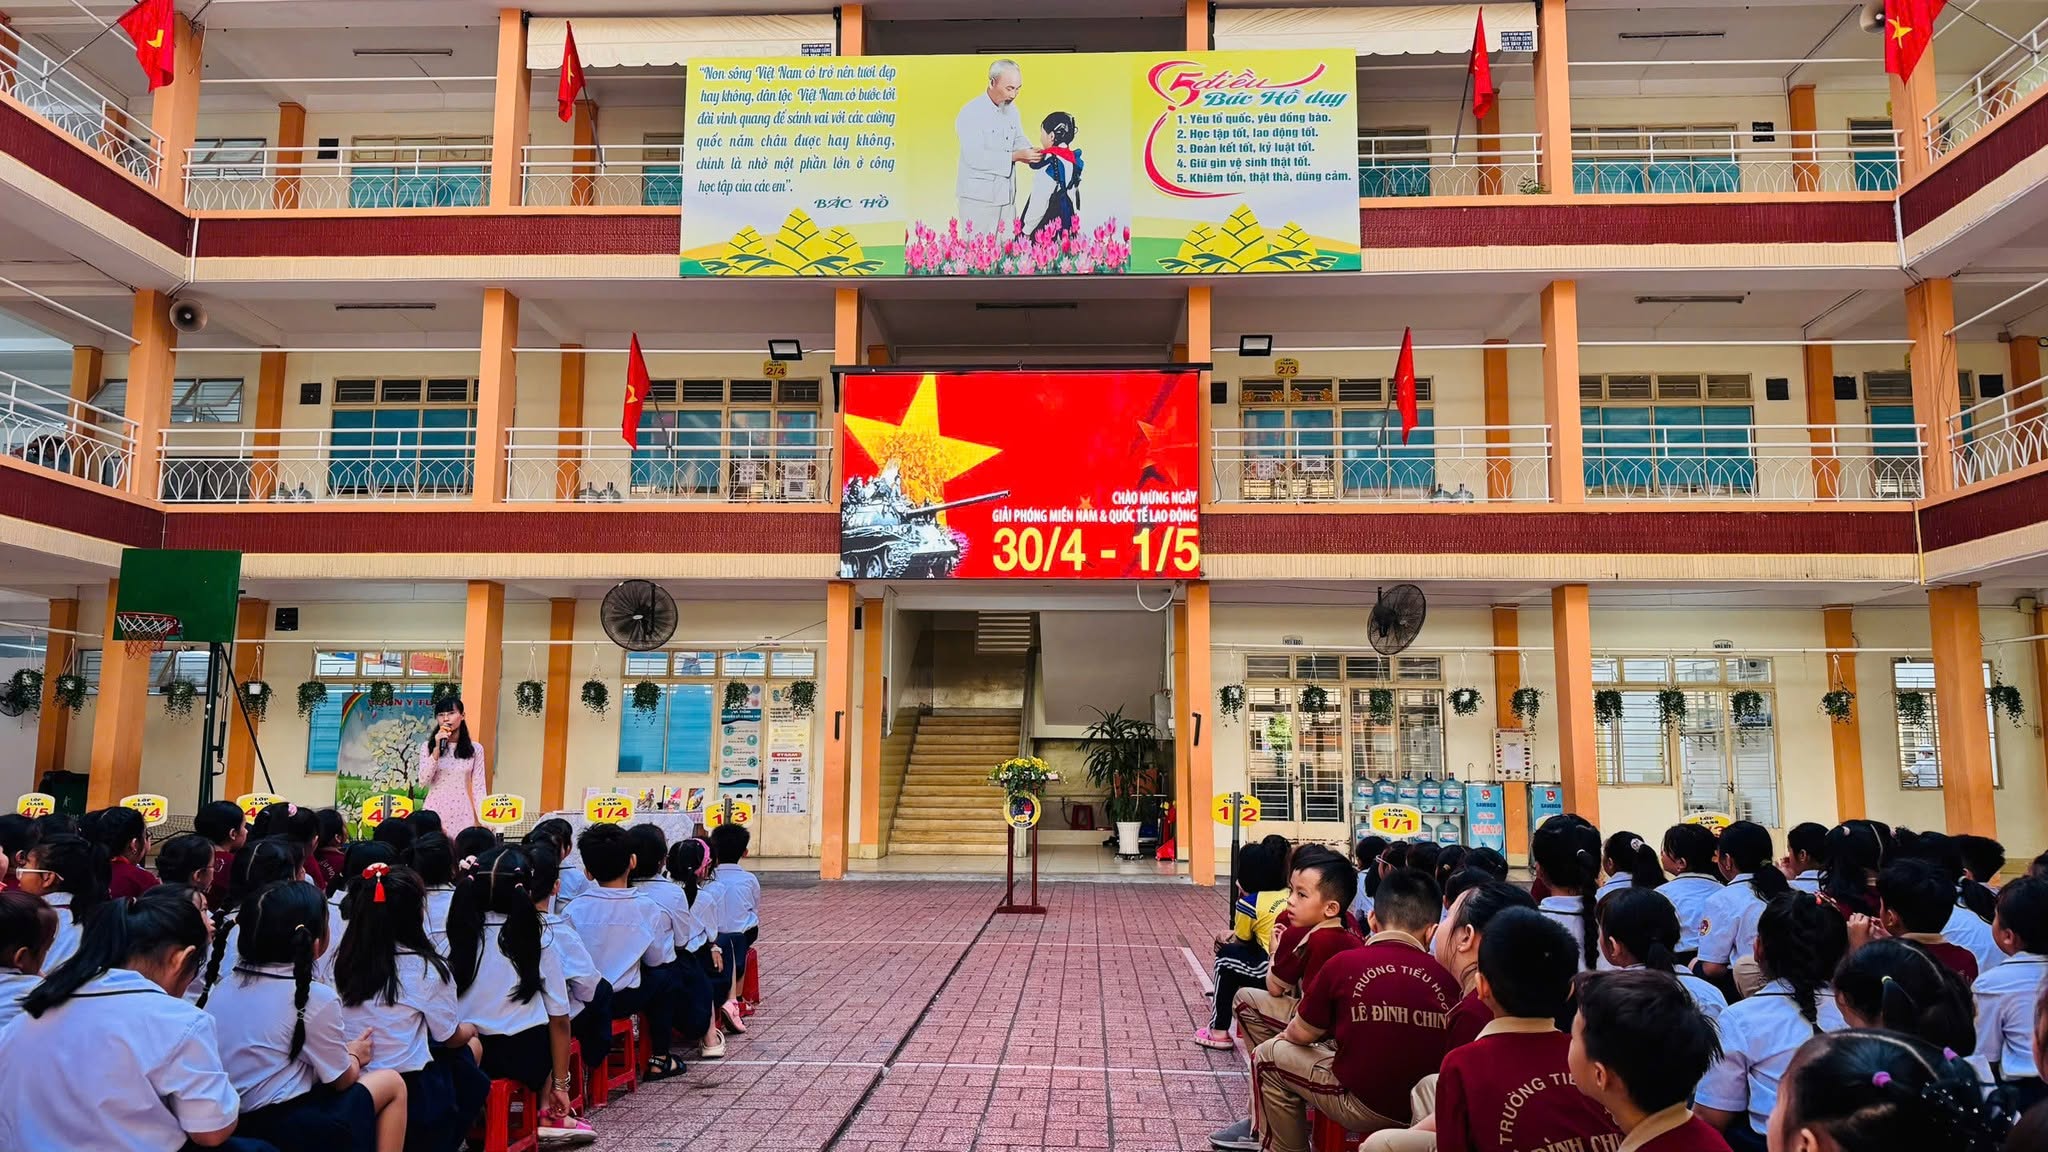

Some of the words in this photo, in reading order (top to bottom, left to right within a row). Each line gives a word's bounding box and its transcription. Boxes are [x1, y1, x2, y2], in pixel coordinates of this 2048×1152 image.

[728, 67, 752, 83] sông
[756, 66, 774, 82] Việt
[778, 66, 802, 79] Nam
[805, 66, 816, 78] có
[819, 65, 834, 78] trở
[836, 65, 854, 78] nên
[858, 66, 876, 78] tươi
[878, 64, 896, 80] đẹp
[1169, 72, 1203, 107] 5
[1192, 67, 1300, 88] điều
[700, 90, 719, 105] hay
[721, 89, 754, 106] không,
[756, 88, 776, 102] dân
[778, 88, 792, 104] tộc
[798, 88, 816, 104] Việt
[820, 88, 843, 100] Nam
[846, 88, 856, 100] có
[858, 88, 881, 100] bước
[882, 88, 896, 100] tới
[1204, 92, 1253, 106] Bác
[1260, 88, 1300, 106] Hồ
[1304, 90, 1348, 108] dạy
[698, 112, 714, 124] đài
[716, 112, 736, 124] vinh
[740, 114, 770, 128] quang
[773, 108, 787, 124] để
[787, 110, 811, 124] sánh
[814, 112, 828, 124] vai
[832, 110, 846, 124] với
[848, 110, 864, 124] các
[866, 110, 896, 126] cường
[1178, 115, 1186, 124] 1.
[1190, 114, 1209, 124] Yêu
[1212, 112, 1224, 124] tổ
[1226, 112, 1254, 124] quốc,
[1258, 113, 1276, 124] yêu
[1176, 130, 1186, 138] 2.
[1190, 129, 1210, 140] Học
[1213, 128, 1230, 140] tập
[1233, 126, 1250, 138] tốt,
[1252, 128, 1269, 138] lao
[1272, 128, 1298, 140] động
[1302, 126, 1318, 137] tốt.
[696, 132, 723, 151] quốc
[729, 134, 754, 147] năm
[760, 134, 787, 147] châu
[794, 134, 821, 150] được
[828, 134, 850, 150] hay
[856, 132, 895, 150] không,
[1176, 144, 1186, 153] 3.
[1190, 144, 1216, 153] Đoàn
[1220, 142, 1236, 152] kết
[1239, 142, 1256, 153] tốt,
[1274, 142, 1295, 154] luật
[1298, 140, 1315, 152] tốt.
[696, 156, 724, 170] chính
[730, 156, 742, 170] là
[748, 156, 768, 170] nhờ
[774, 156, 794, 172] một
[800, 154, 826, 174] phần
[832, 156, 850, 169] lớn
[856, 156, 864, 169] ở
[870, 156, 895, 172] công
[1176, 158, 1186, 168] 4.
[1230, 158, 1242, 170] vệ
[1245, 158, 1268, 167] sinh
[1270, 157, 1290, 168] thật
[1294, 155, 1310, 166] tốt.
[1176, 174, 1186, 182] 5.
[1190, 173, 1223, 182] Khiêm
[1226, 171, 1246, 183] tốn,
[1250, 172, 1270, 184] thật
[698, 180, 716, 195] học
[717, 179, 733, 196] tập
[735, 178, 752, 192] của
[754, 179, 770, 192] các
[814, 196, 852, 208] BÁC
[860, 194, 889, 208] HỒ
[766, 367, 785, 376] 2/4
[1278, 366, 1298, 374] 2/3
[1112, 488, 1138, 504] CHÀO
[1140, 488, 1169, 504] MỪNG
[1171, 488, 1198, 504] NGÀY
[992, 505, 1012, 522] GIẢI
[1014, 506, 1048, 522] PHÓNG
[1076, 509, 1098, 522] NAM
[1100, 510, 1108, 522] &
[1108, 506, 1136, 524] QUỐC
[1136, 505, 1148, 522] TẾ
[1149, 509, 1168, 522] LAO
[1169, 506, 1197, 526] ĐỘNG
[992, 526, 1086, 572] 30/4
[1100, 550, 1116, 558] -
[1132, 526, 1200, 572] 1/5
[22, 807, 48, 816] 4/5
[142, 808, 161, 818] /4
[368, 808, 410, 822] 42
[485, 808, 517, 818] 4/1
[593, 807, 629, 818] 1/4
[712, 812, 748, 824] 13
[1218, 806, 1257, 822] 12
[1379, 818, 1412, 830] 1/1
[1352, 964, 1396, 998] TRƯỜNG
[1400, 966, 1432, 983] TIỂU
[1350, 1002, 1368, 1022] LÊ
[1371, 1000, 1408, 1024] ĐÌNH
[1500, 1078, 1546, 1145] TRƯỜNG
